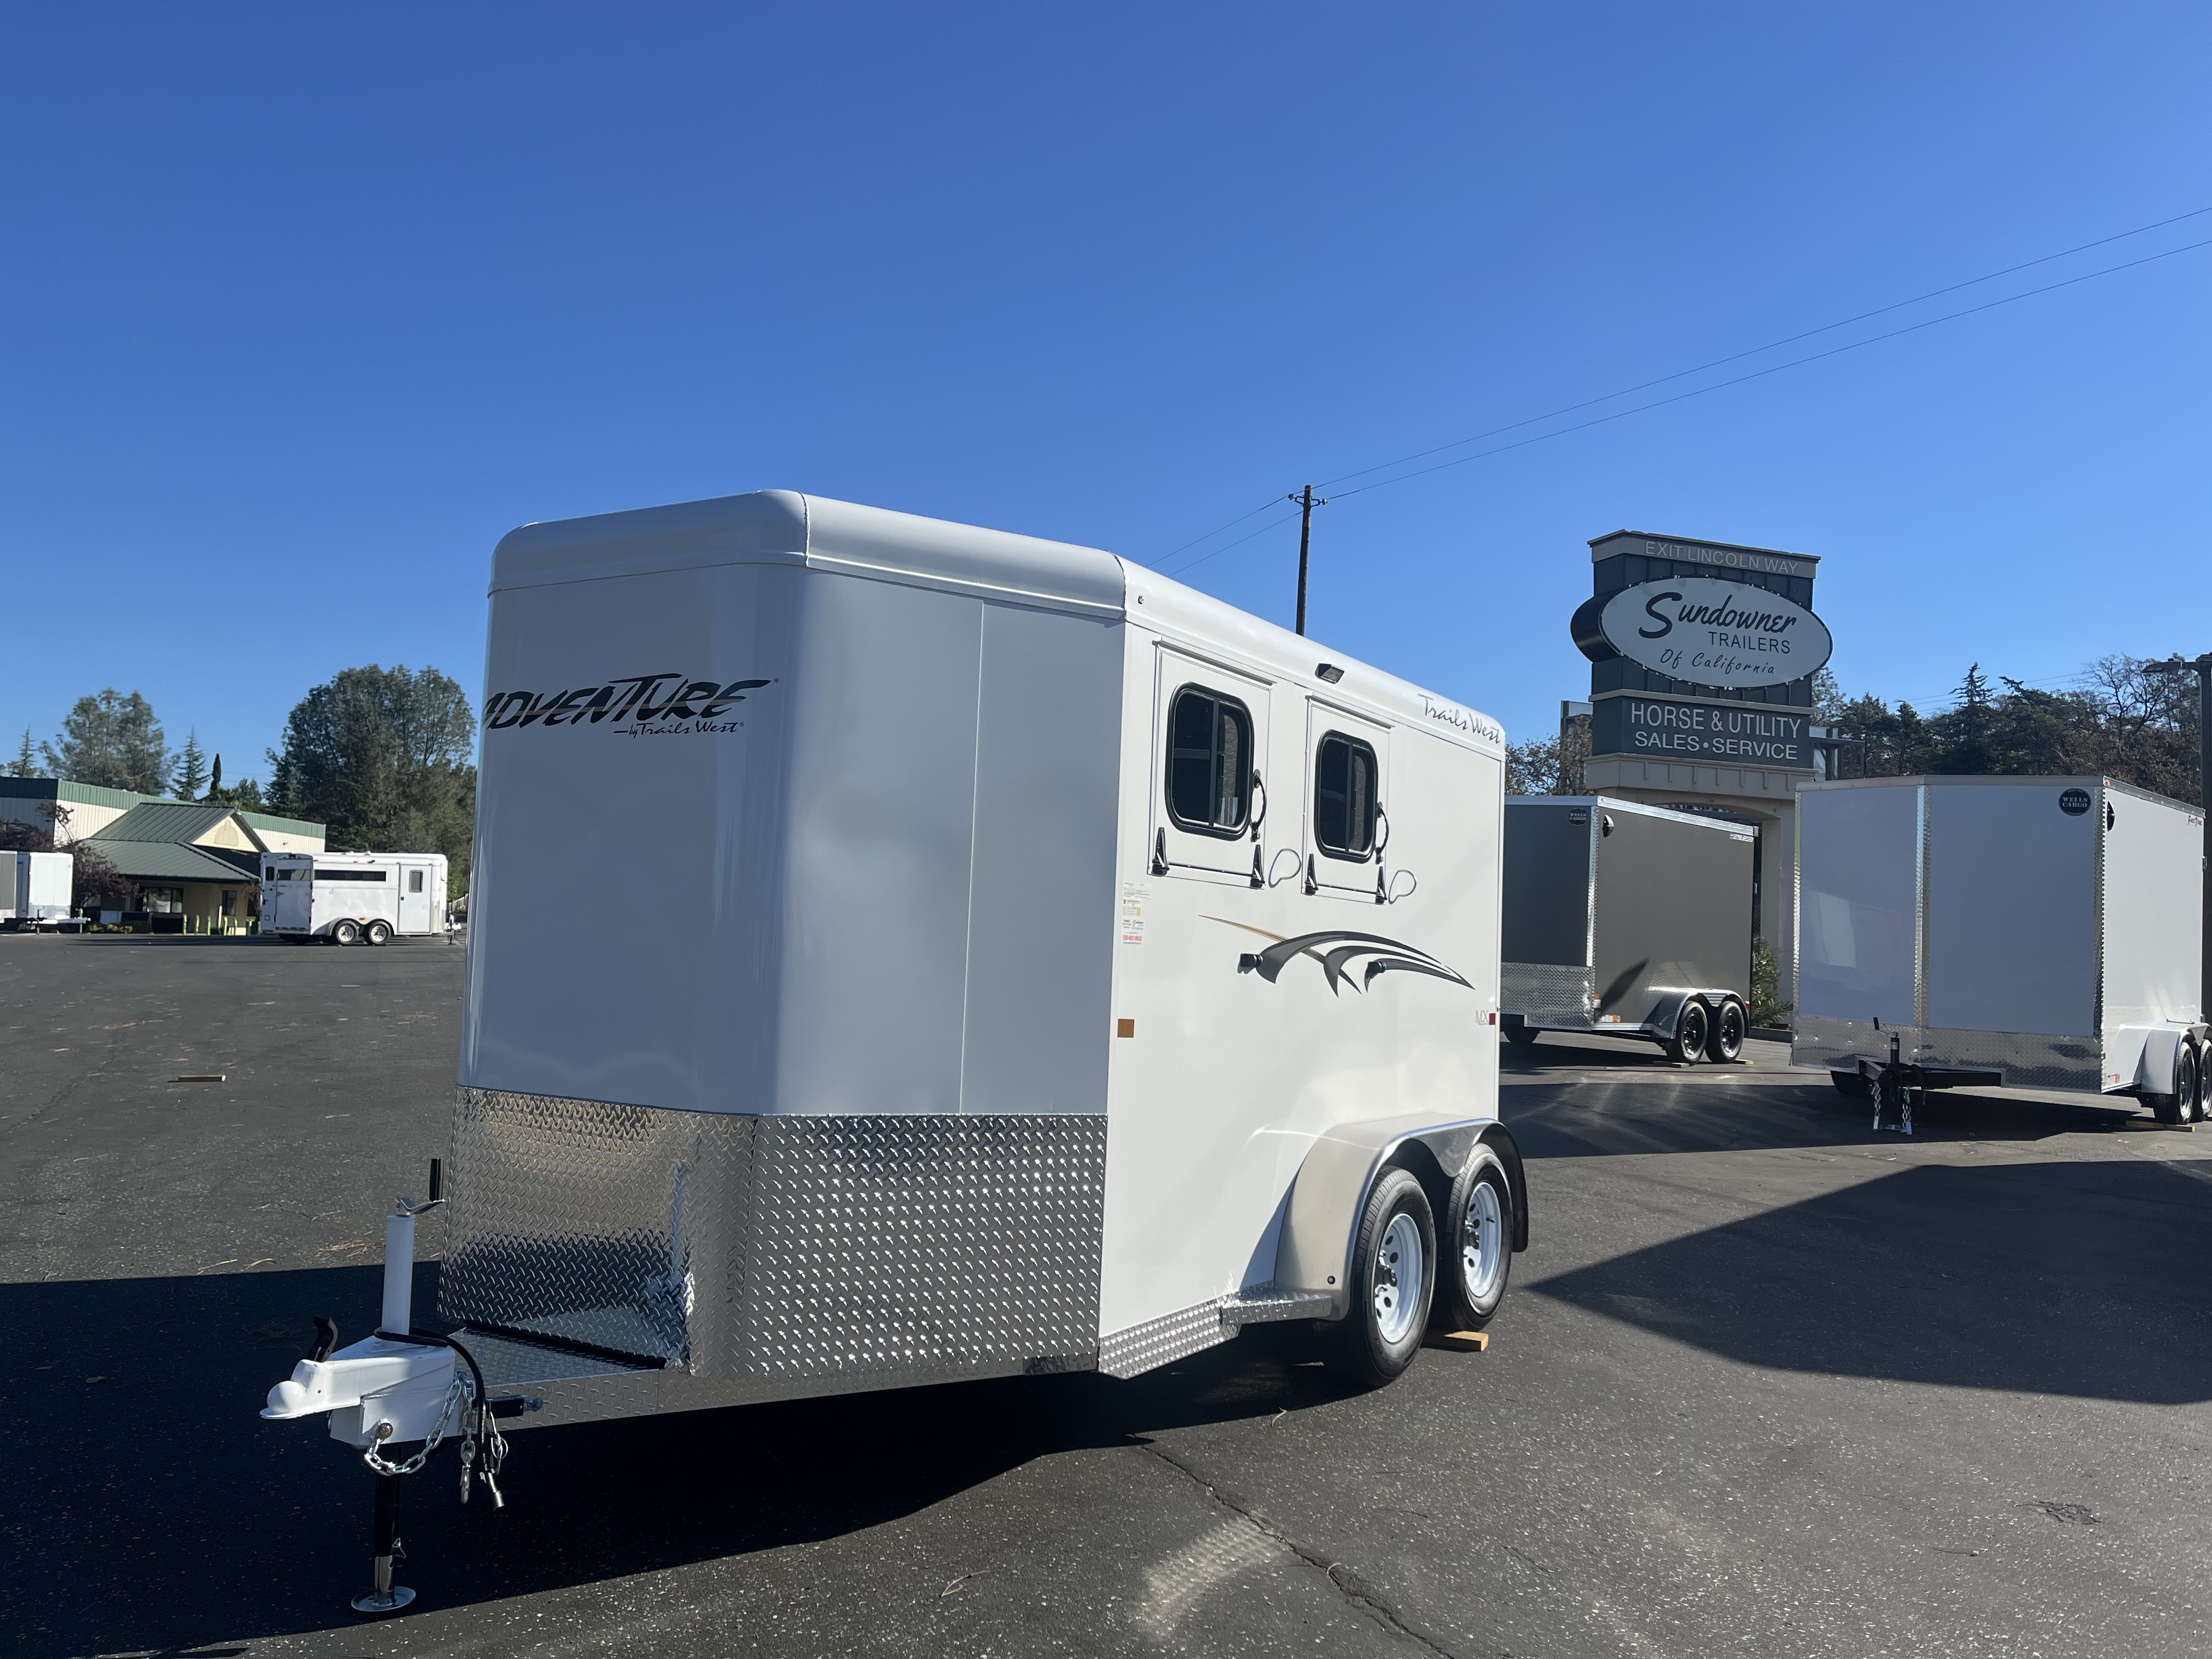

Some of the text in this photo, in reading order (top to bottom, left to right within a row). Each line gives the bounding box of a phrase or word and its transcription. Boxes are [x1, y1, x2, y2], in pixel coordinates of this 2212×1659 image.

[1645, 541, 1798, 574] EXIT LINCOLN WAY
[1638, 591, 1797, 639] Sundowner
[1708, 631, 1791, 654] TRAILERS
[1660, 648, 1775, 675] Of California
[636, 722, 690, 736] Trails
[695, 720, 738, 733] West
[1418, 693, 1500, 744] Trails West
[1630, 702, 1802, 739] HORSE & UTILITY
